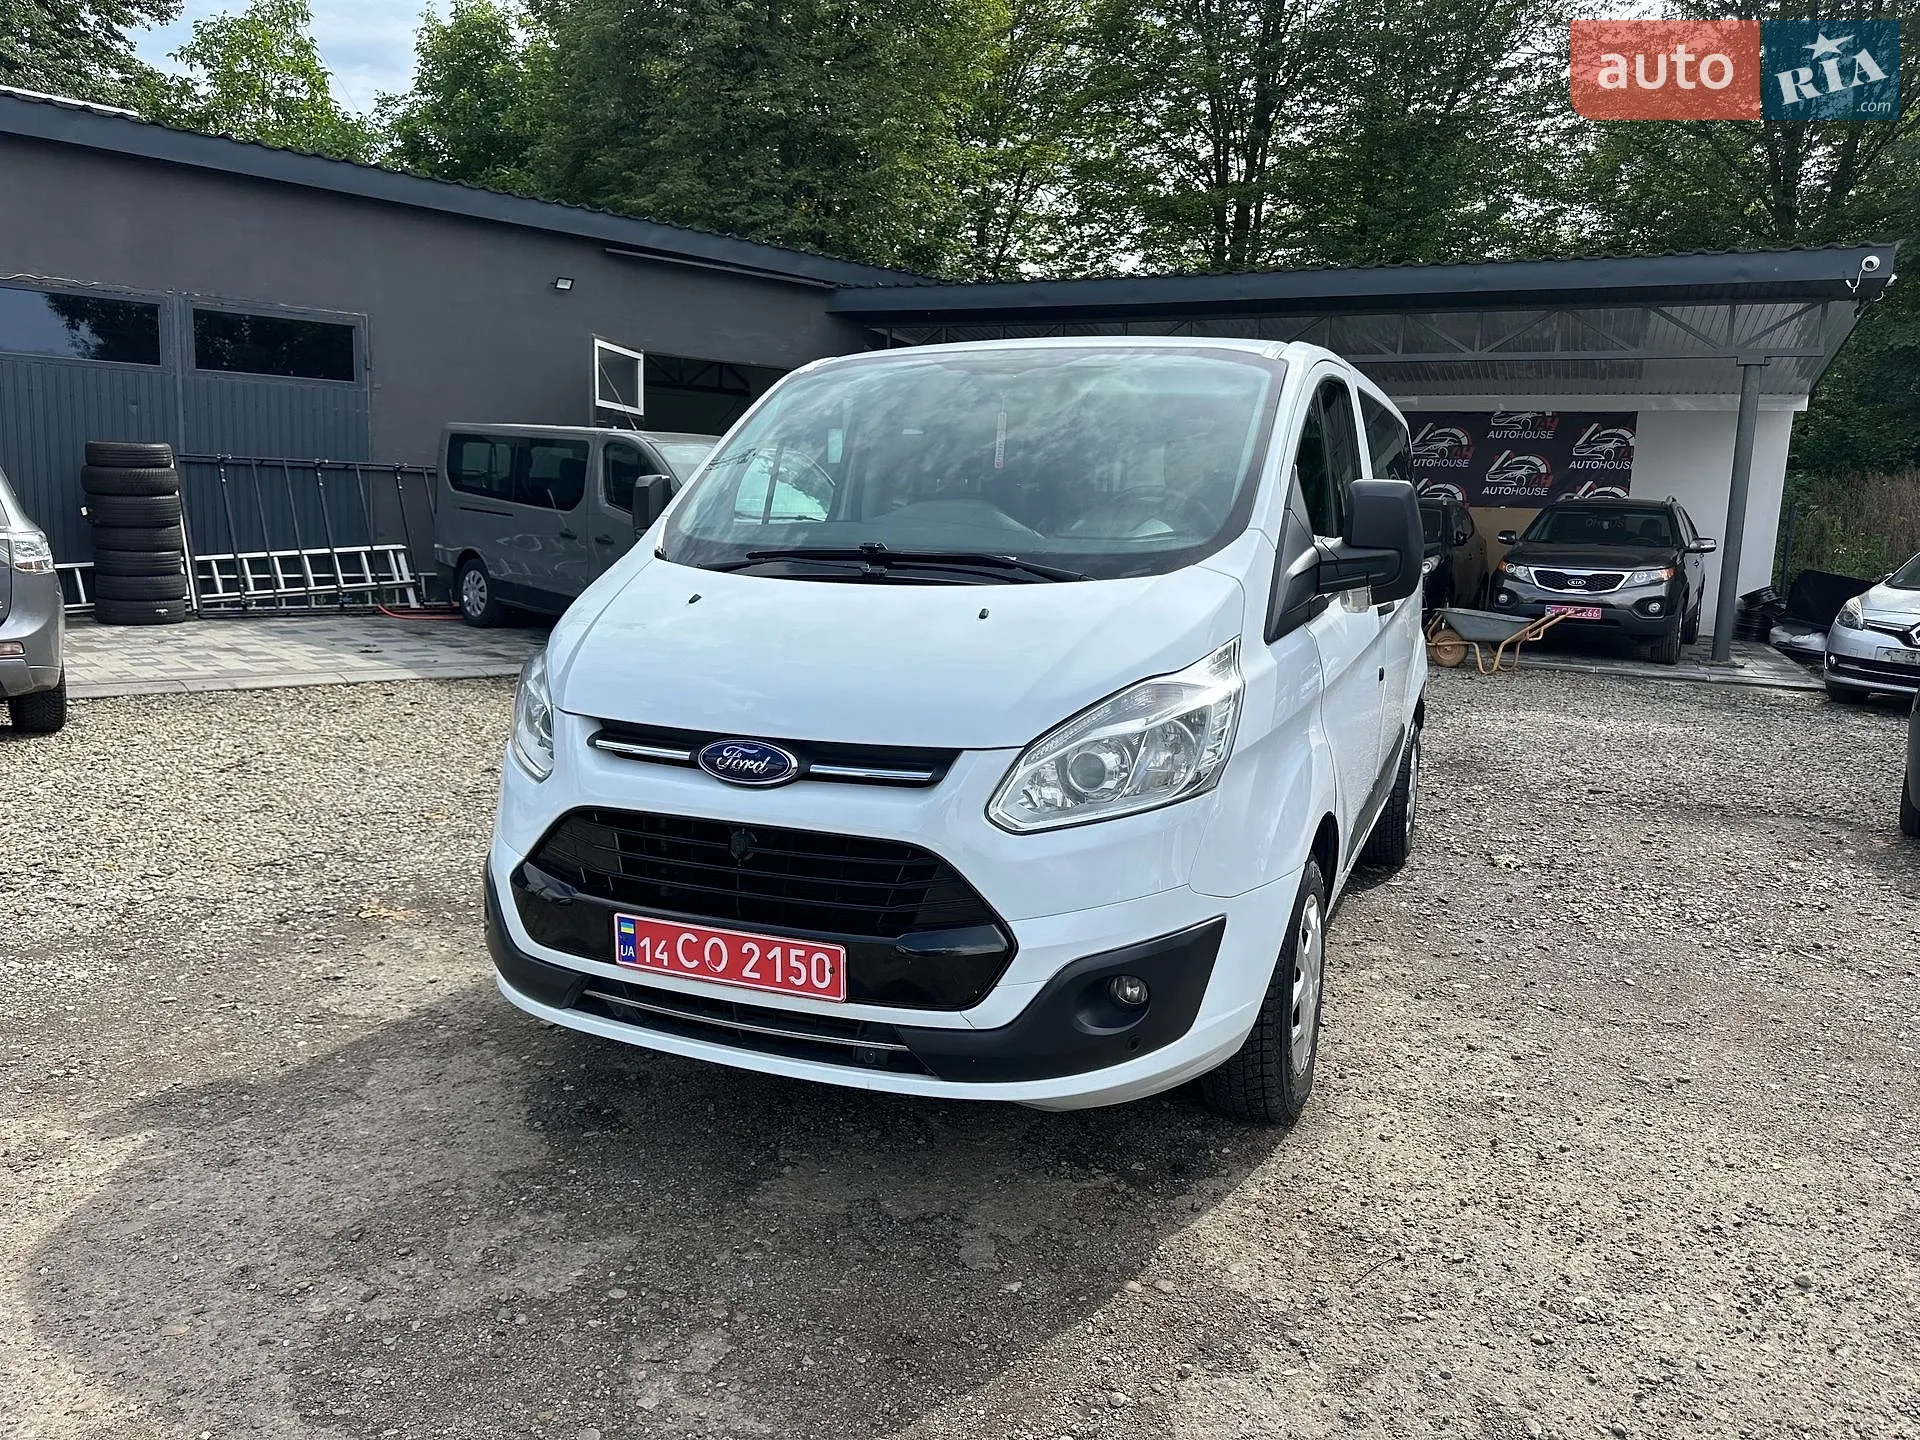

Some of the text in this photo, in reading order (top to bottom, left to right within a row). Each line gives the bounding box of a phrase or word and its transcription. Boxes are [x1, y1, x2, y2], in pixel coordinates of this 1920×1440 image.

[1487, 430, 1555, 439] AUTOHOUSE
[1412, 459, 1471, 468] UTOHOUSE
[1568, 460, 1632, 470] AUTOHOUS
[1482, 486, 1549, 496] AUTOHOUSE
[715, 745, 772, 774] Ford
[620, 944, 635, 958] UA
[741, 942, 832, 989] 2150
